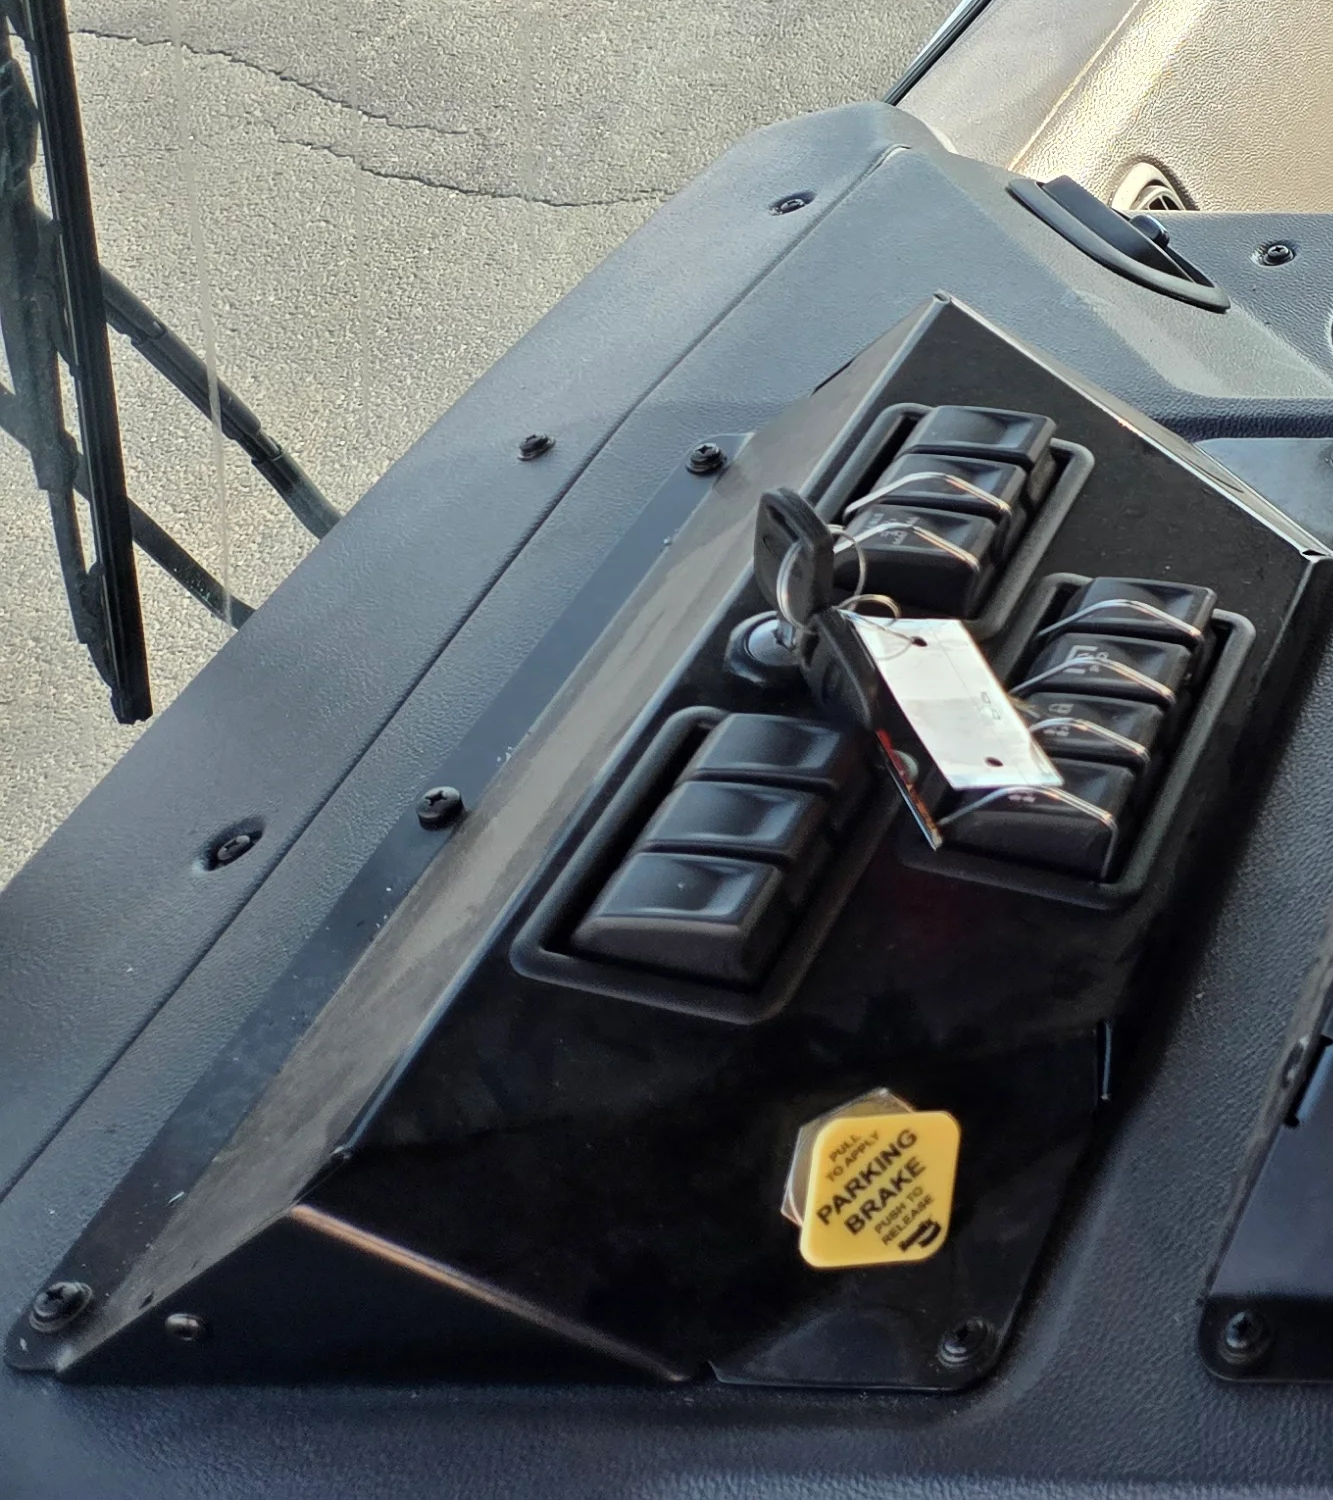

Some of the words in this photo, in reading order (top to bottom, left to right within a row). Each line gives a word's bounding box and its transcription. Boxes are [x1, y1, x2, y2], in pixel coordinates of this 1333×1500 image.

[826, 1166, 844, 1181] TO
[844, 1130, 879, 1167] APPLY
[829, 1134, 861, 1162] PULL
[816, 1129, 917, 1225] PARKING
[844, 1156, 926, 1235] BRAKE
[874, 1203, 907, 1234] PUSH
[906, 1186, 924, 1203] TO
[881, 1194, 933, 1245] RELEASE
